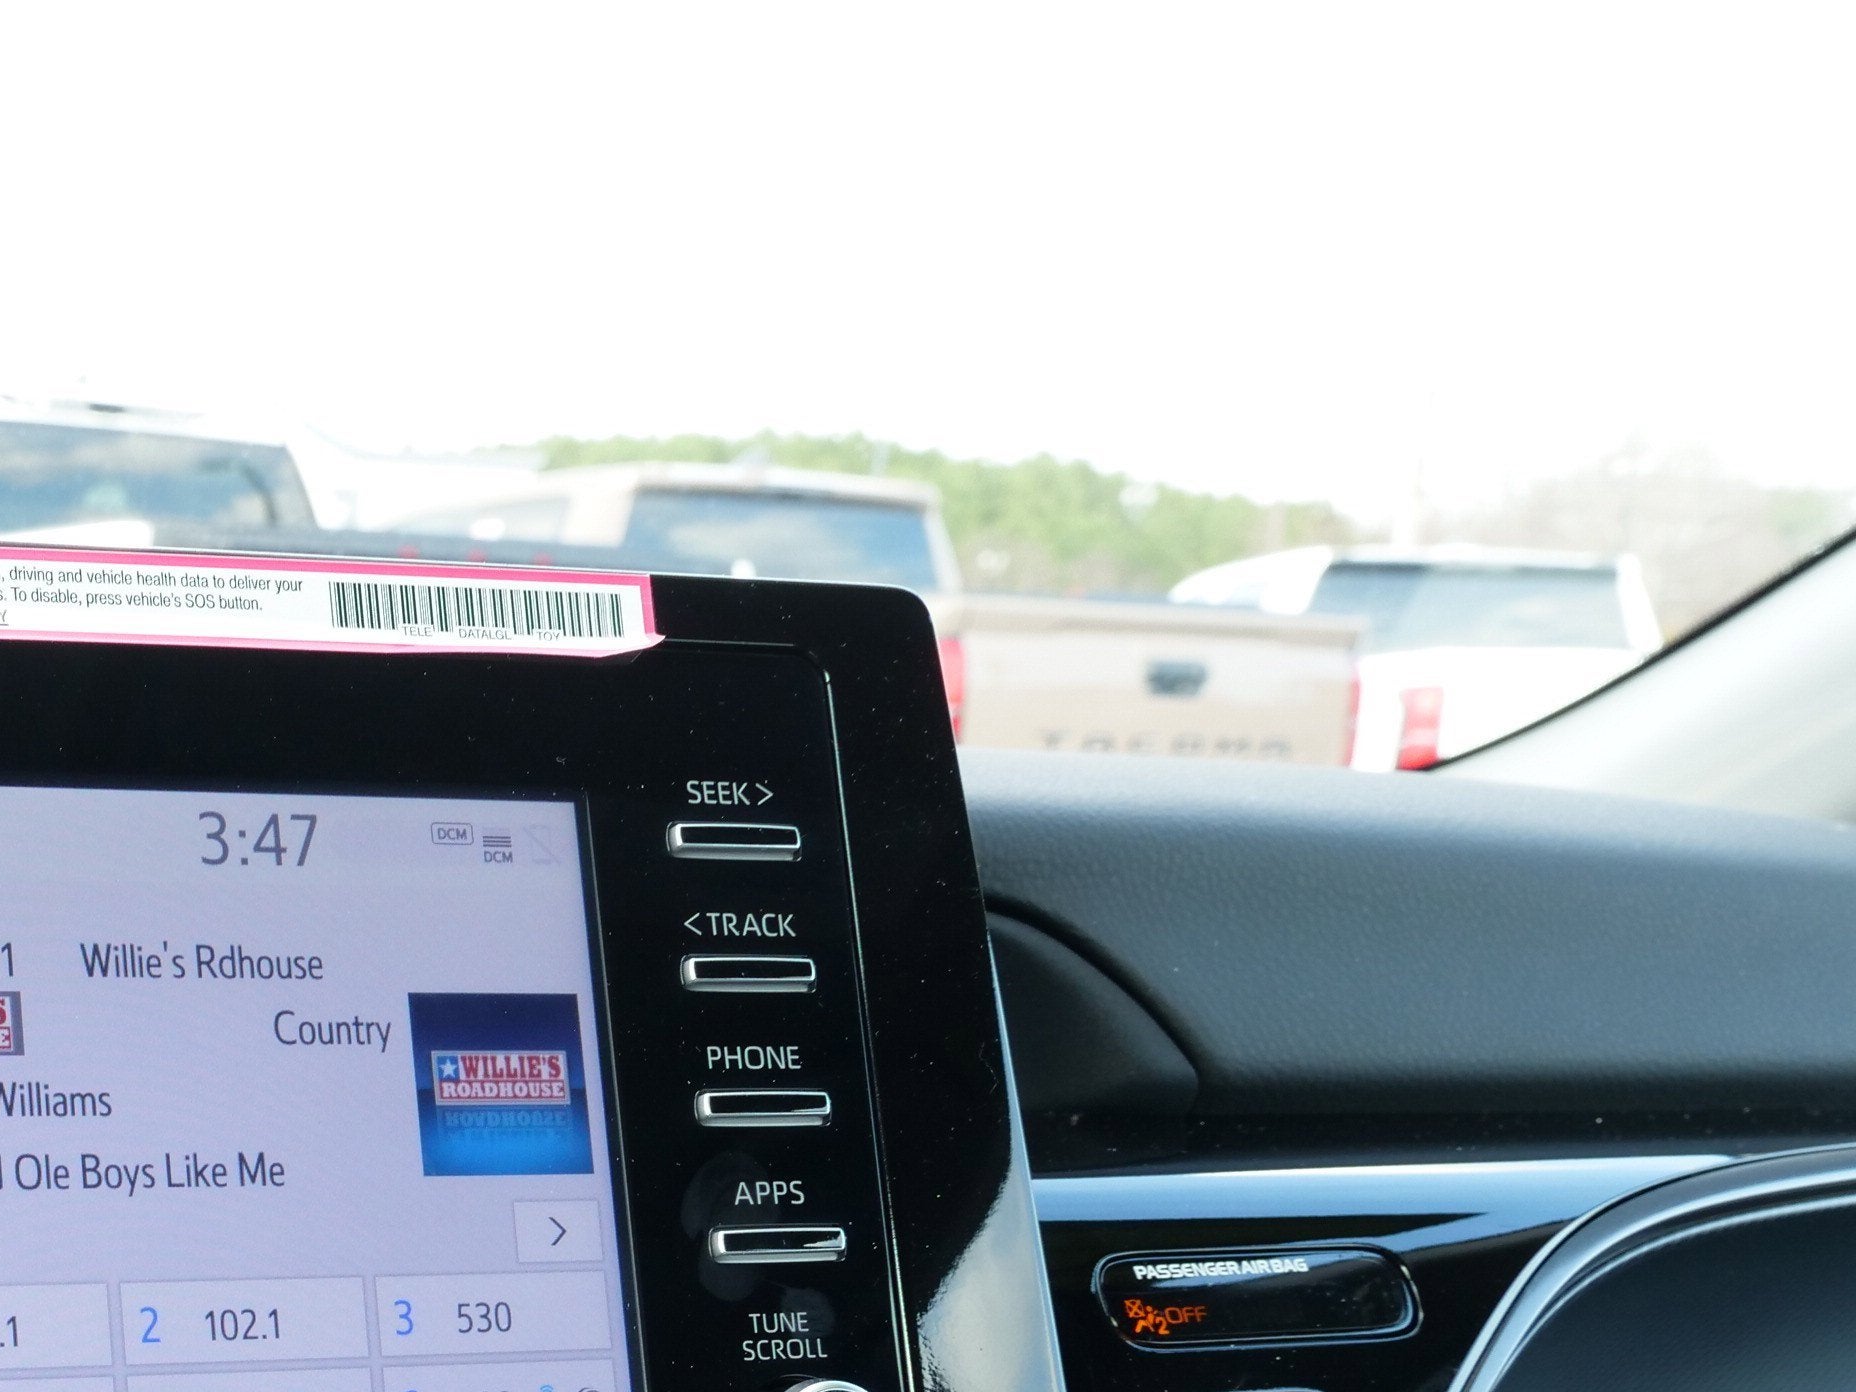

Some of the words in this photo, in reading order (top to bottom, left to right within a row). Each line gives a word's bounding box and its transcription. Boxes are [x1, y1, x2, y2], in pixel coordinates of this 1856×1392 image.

[9, 566, 54, 585] driving
[58, 568, 83, 583] and
[86, 569, 133, 586] vehicle
[137, 571, 177, 587] health
[181, 572, 209, 588] data
[213, 575, 225, 589] to
[229, 575, 271, 591] deliver
[275, 579, 303, 594] your
[10, 587, 27, 602] To
[31, 588, 82, 606] disable,
[86, 592, 122, 609] press
[125, 591, 181, 609] vehicle's
[185, 594, 215, 610] SOS
[219, 595, 263, 612] button.
[402, 626, 433, 637] TELE
[537, 631, 561, 642] TOY
[197, 810, 319, 868] 3:47
[437, 828, 468, 841] DCM
[483, 851, 514, 863] DCM
[79, 941, 186, 980] Willie's
[195, 944, 324, 981] Rdhouse
[273, 1009, 392, 1053] Country
[460, 1055, 562, 1079] WILLIE'S
[706, 1046, 802, 1070] PHONE
[441, 1081, 565, 1098] ROADHOUSE
[15, 1153, 70, 1190] Ole
[80, 1153, 156, 1198] Boys
[165, 1152, 228, 1188] Like
[238, 1152, 286, 1187] Me
[734, 1180, 805, 1206] APPS
[1132, 1260, 1240, 1281] PASSENGER
[1270, 1257, 1310, 1274] BAG
[140, 1306, 162, 1343] 2
[205, 1308, 281, 1341] 102.1
[393, 1299, 415, 1336] 3
[457, 1301, 513, 1334] 530
[748, 1312, 810, 1335] TUNE
[1165, 1306, 1208, 1325] OFF
[742, 1338, 828, 1362] SCROLL
